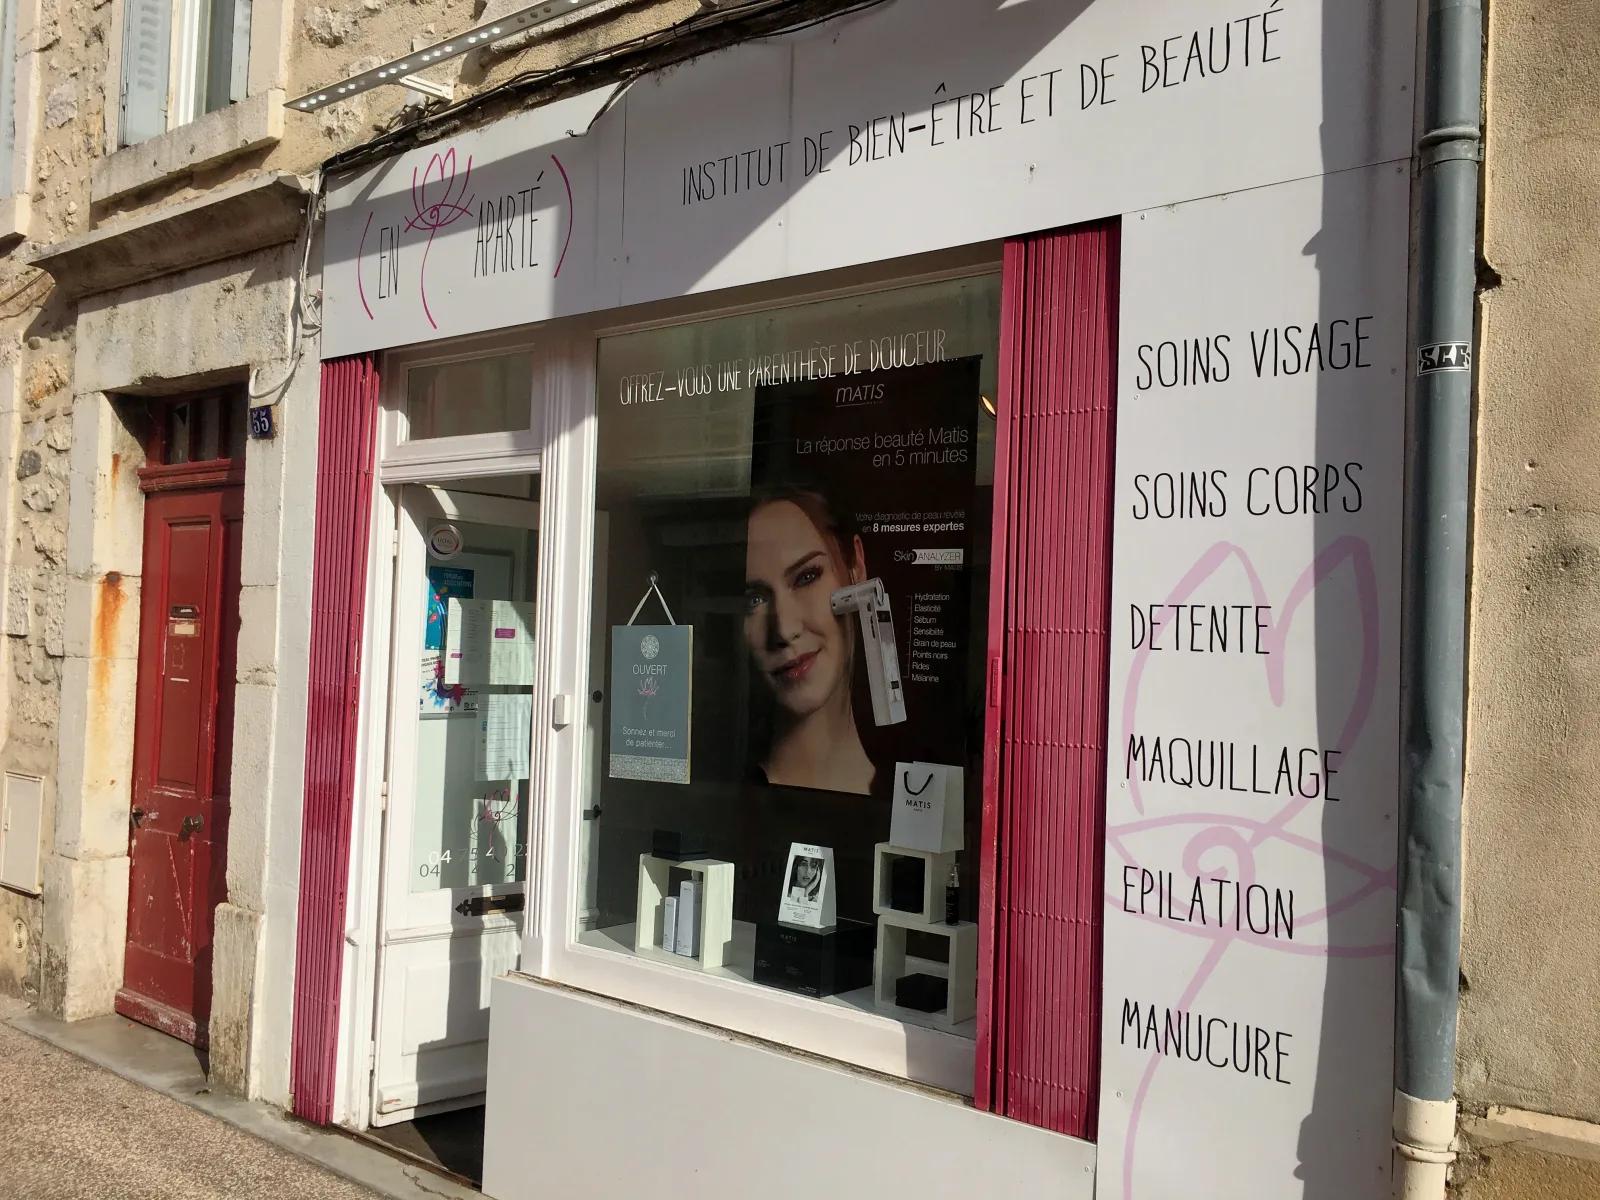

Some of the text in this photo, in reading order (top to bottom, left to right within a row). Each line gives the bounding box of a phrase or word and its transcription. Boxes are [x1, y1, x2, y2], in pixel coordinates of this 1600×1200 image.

[682, 0, 1284, 206] INSTITUT DE BIEN-ÊTRE ET DE BEAUTÉ
[1135, 334, 1231, 391] SOINS
[1250, 315, 1374, 378] VISAGE
[619, 364, 712, 406] OFFREZ-VOUS
[717, 358, 743, 392] UNE
[748, 340, 837, 389] PARENTHÈSE
[844, 340, 863, 376] DE
[252, 409, 270, 434] 55
[796, 426, 969, 456] La réponse beauté Matis
[872, 447, 968, 467] en 5 minutes
[1132, 462, 1364, 520] SOINS CORPS
[855, 513, 873, 522] Votre
[873, 511, 910, 523] diagnostic
[911, 511, 922, 520] de
[922, 511, 942, 522] peau
[861, 521, 965, 534] en 8 mesures expertes
[893, 549, 961, 562] Skin ANALYZER
[914, 593, 950, 602] Hydratation
[913, 616, 937, 624] Sébum
[913, 627, 944, 636] Sensibilité
[1130, 603, 1272, 655] DETENTE
[913, 639, 957, 650] Grain de peau
[912, 651, 948, 660] Points noirs
[632, 664, 668, 676] OUVERT
[912, 662, 930, 671] Rides
[911, 674, 939, 683] Mélanine
[622, 726, 676, 738] Sonnez et merci
[625, 738, 635, 747] de
[1125, 733, 1342, 802] MAQUILLAGE
[905, 799, 931, 809] MATIS
[803, 846, 819, 854] MATIS
[1123, 865, 1294, 940] EPILATION
[779, 933, 797, 943] MATIS
[1120, 997, 1293, 1085] MANUCURE
